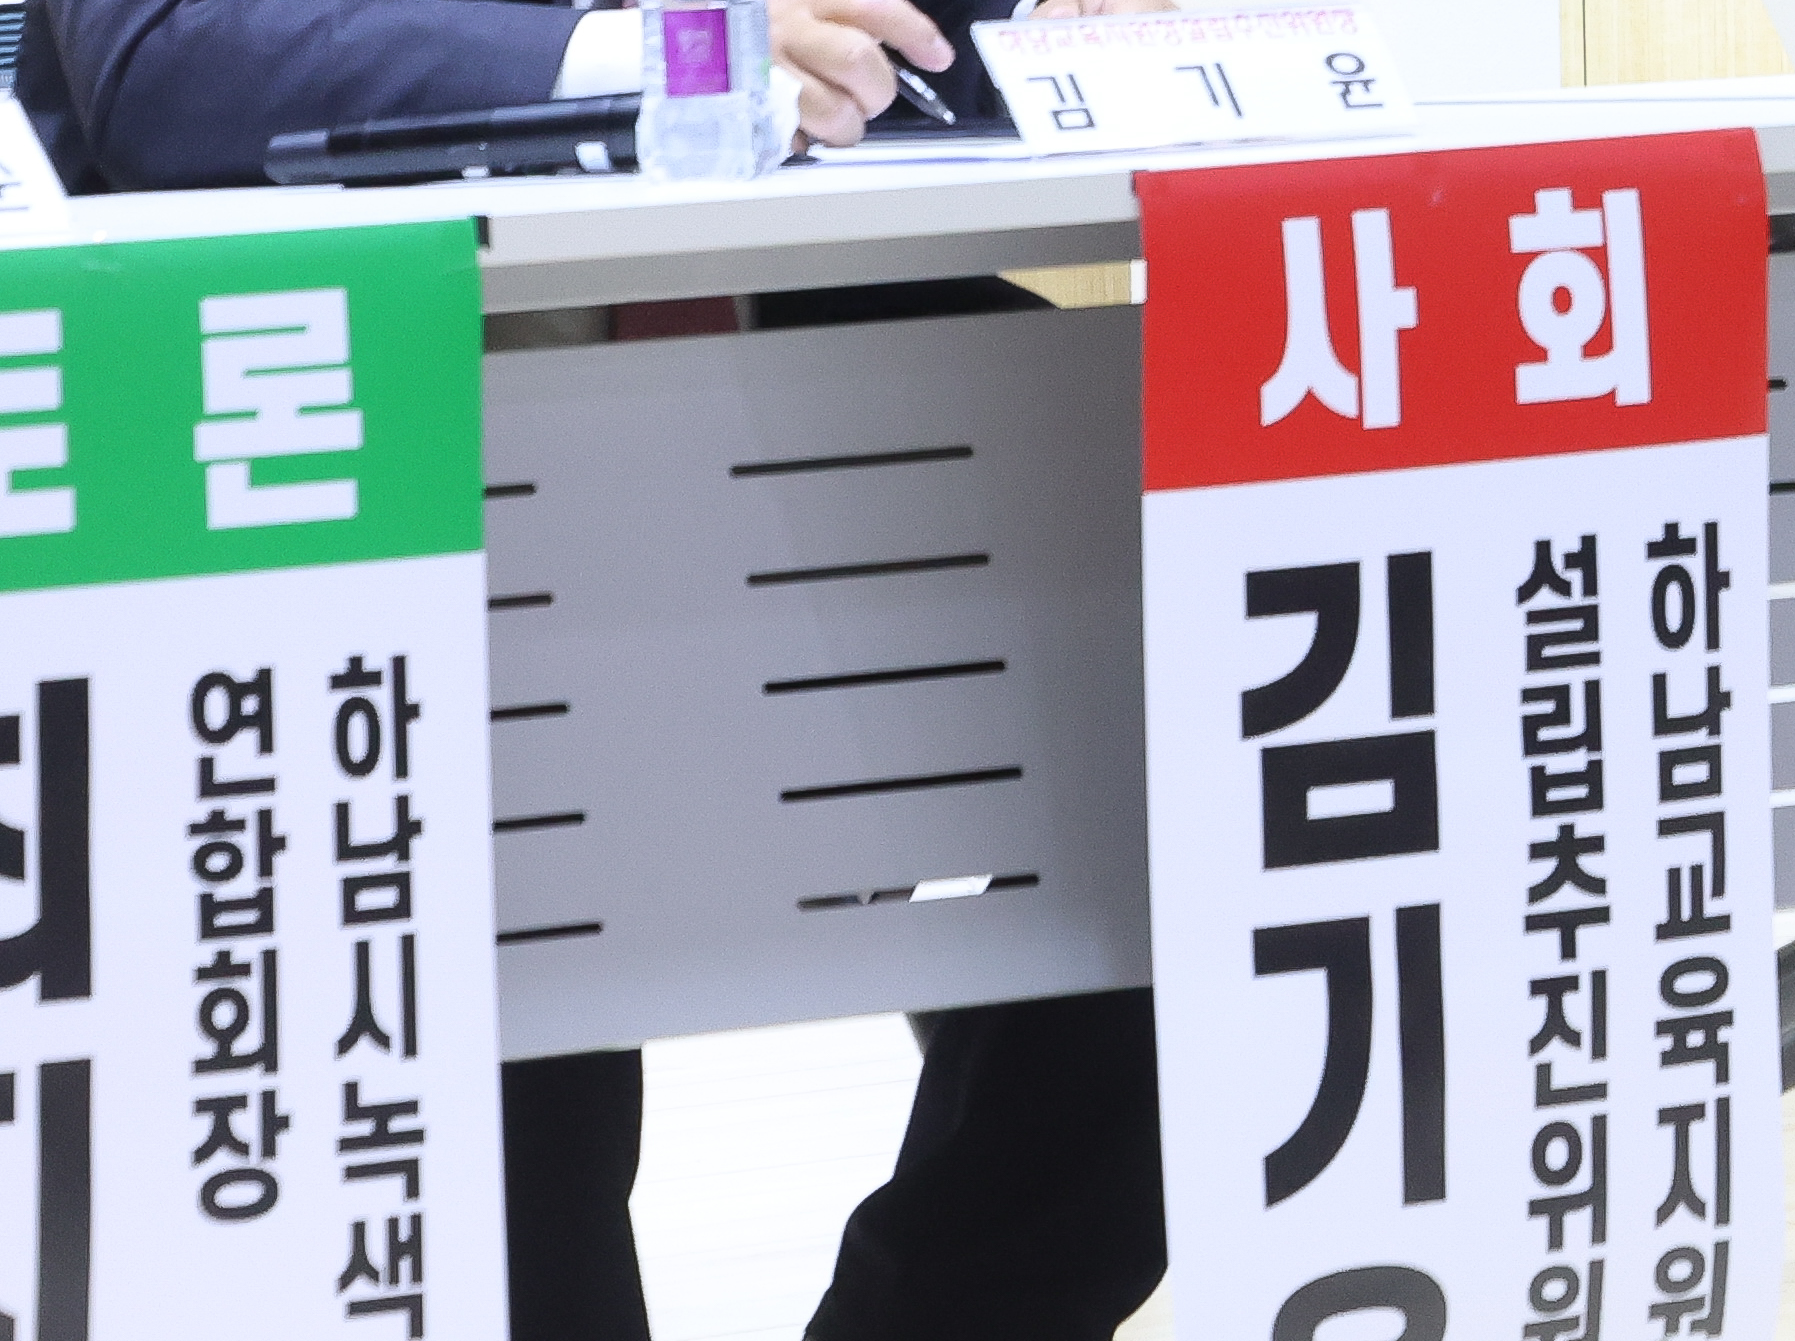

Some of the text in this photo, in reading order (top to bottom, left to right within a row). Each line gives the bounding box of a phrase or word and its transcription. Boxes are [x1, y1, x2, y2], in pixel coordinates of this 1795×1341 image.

[1259, 186, 1652, 431] 사회
[188, 666, 290, 1222] 연합회장
[330, 654, 425, 1341] 하남시녹색
[1240, 549, 1448, 1341] 김기
